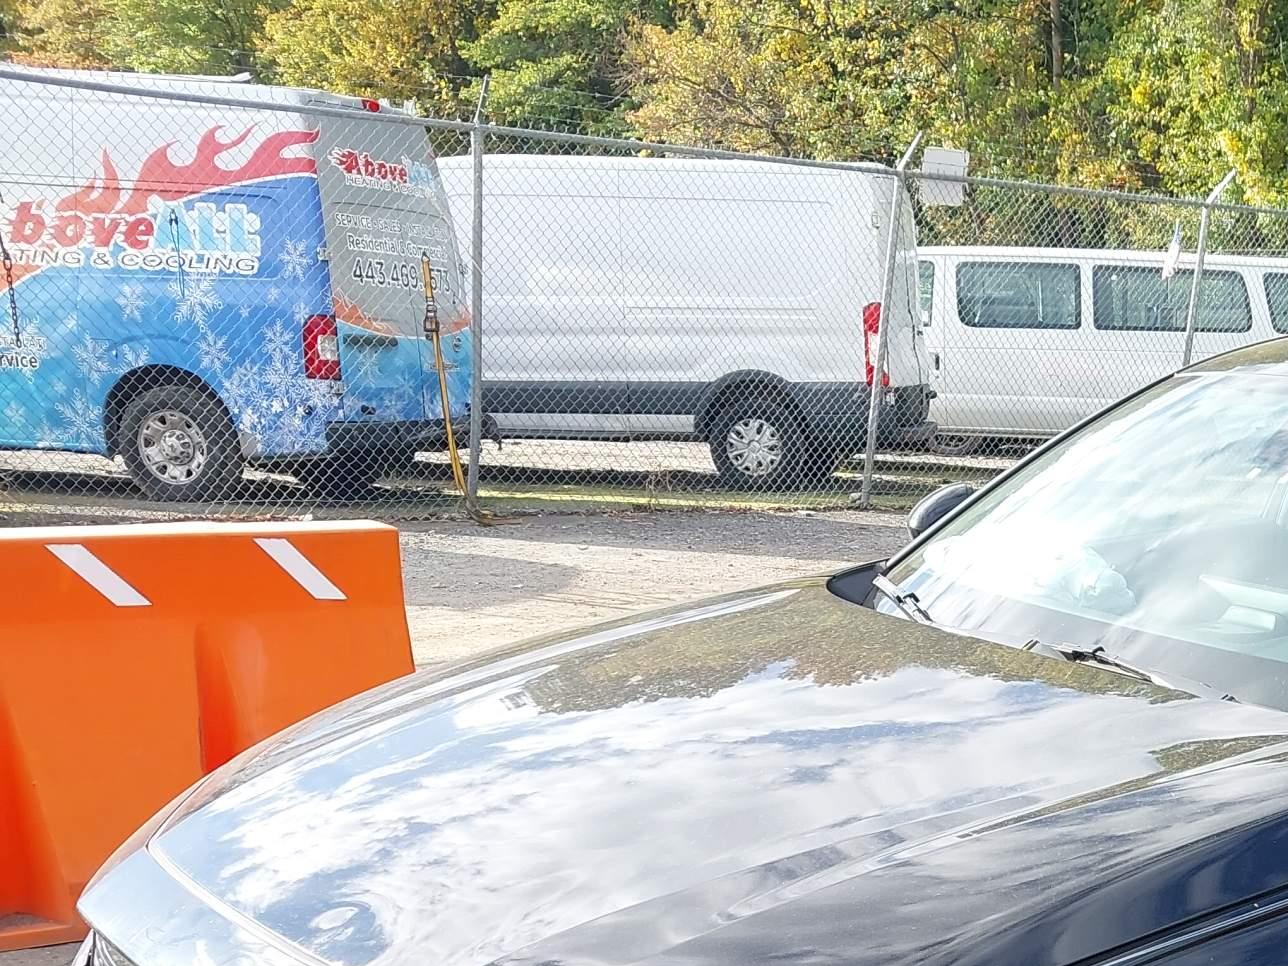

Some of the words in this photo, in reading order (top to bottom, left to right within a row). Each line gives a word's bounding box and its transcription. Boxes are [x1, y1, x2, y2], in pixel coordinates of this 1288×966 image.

[335, 213, 372, 230] SERVICE
[93, 252, 110, 266] &
[121, 253, 257, 272] COOLING
